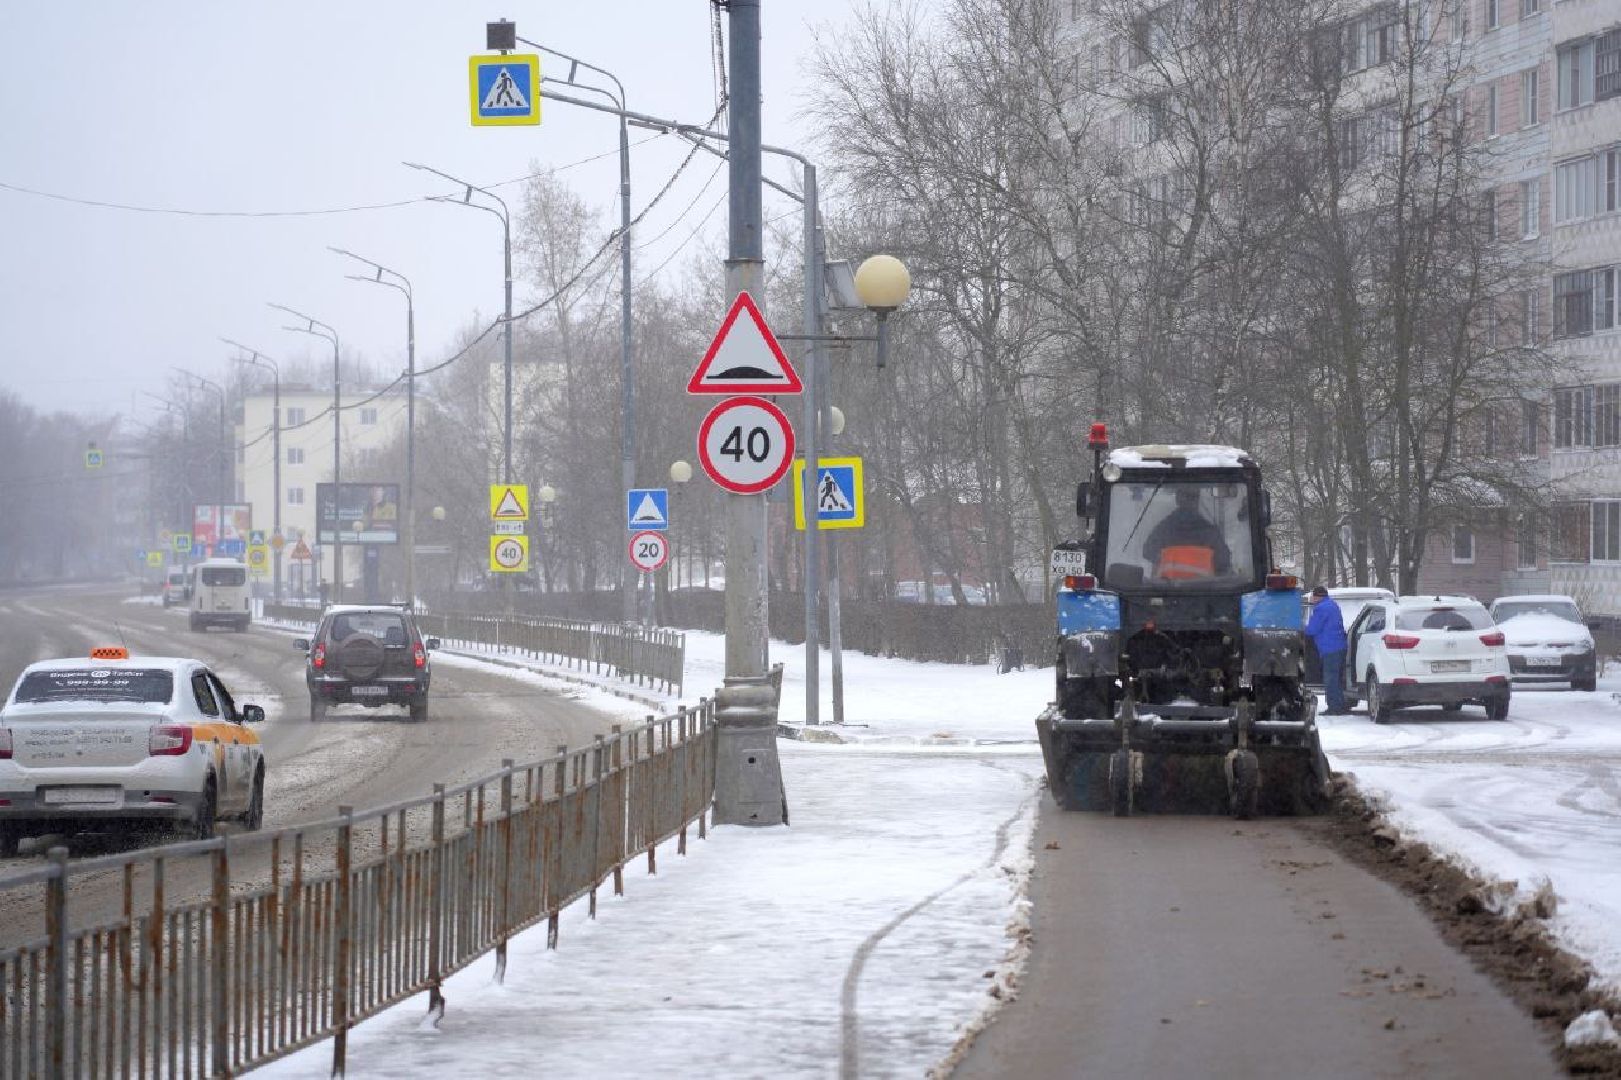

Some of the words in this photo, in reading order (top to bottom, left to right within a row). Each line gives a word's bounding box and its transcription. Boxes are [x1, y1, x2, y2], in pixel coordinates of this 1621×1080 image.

[720, 425, 770, 463] 40
[501, 547, 517, 559] 40
[638, 542, 659, 558] 20
